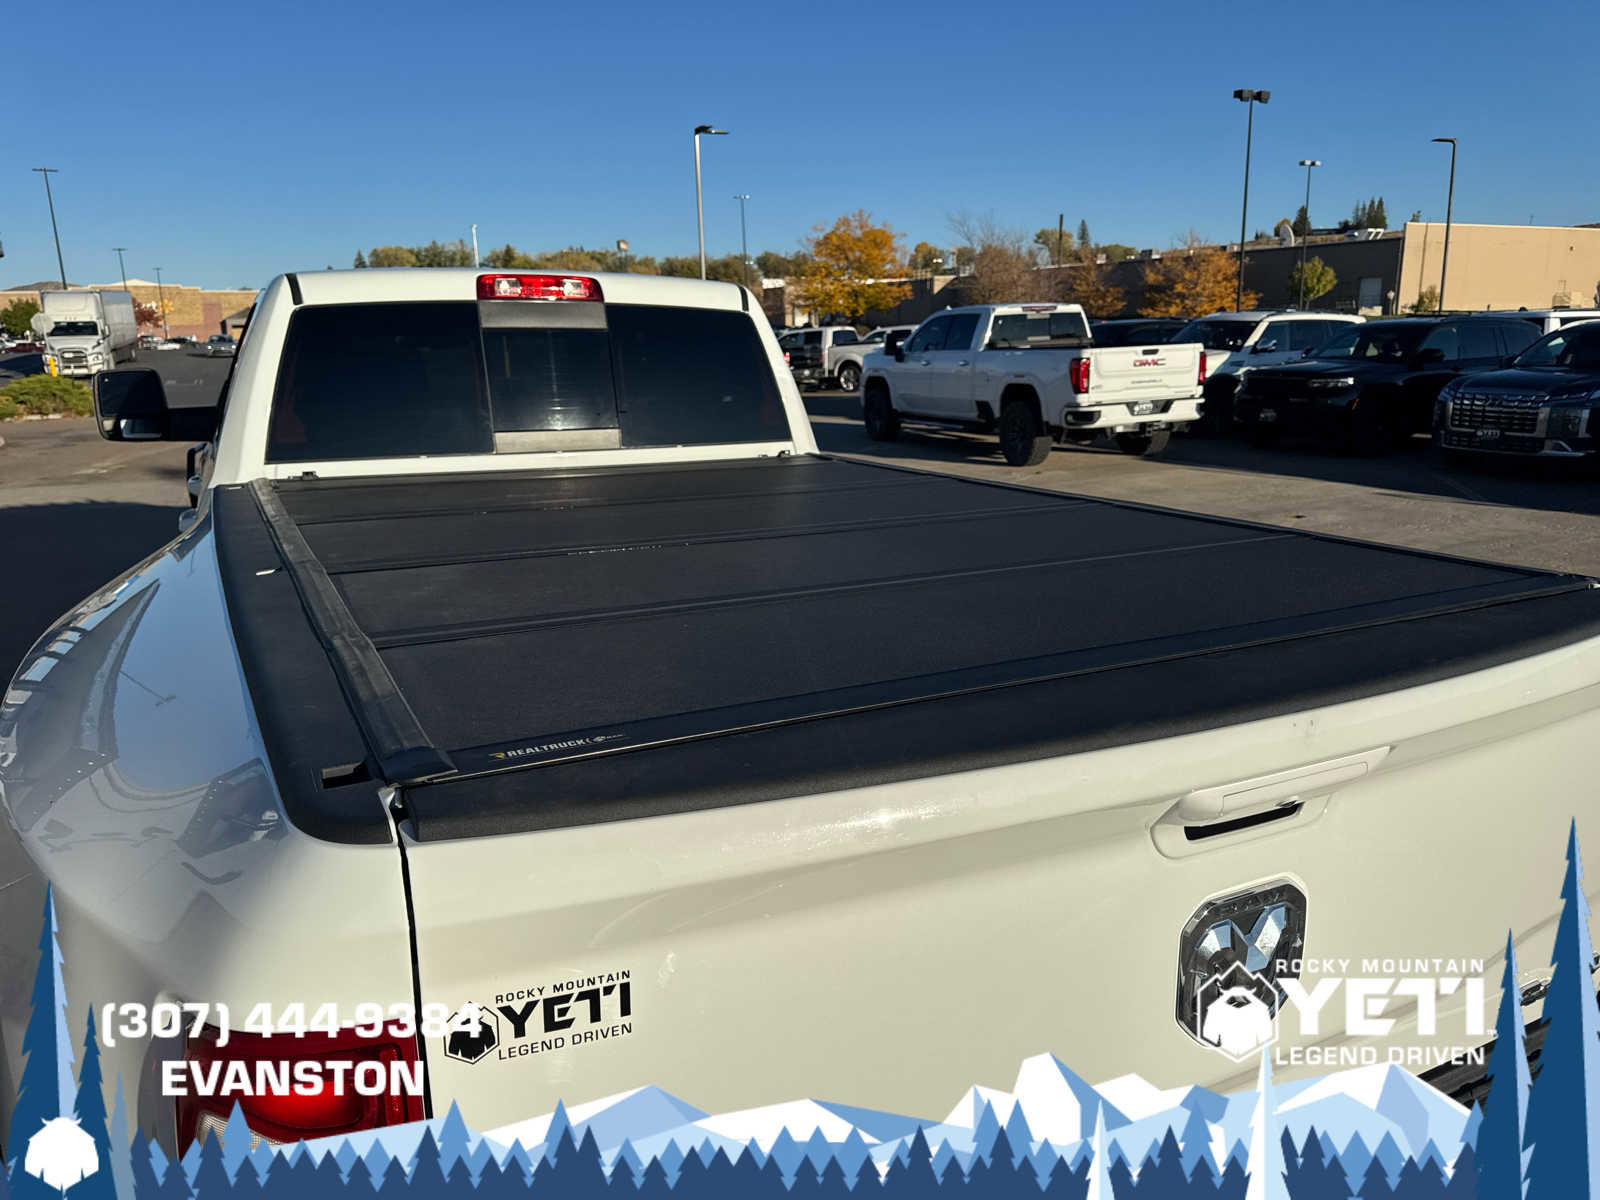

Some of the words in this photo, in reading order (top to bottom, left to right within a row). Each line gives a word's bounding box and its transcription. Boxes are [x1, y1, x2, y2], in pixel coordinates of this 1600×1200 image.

[1132, 358, 1167, 368] GMC
[506, 738, 586, 758] REALTRUCK
[495, 986, 545, 1004] ROCKY
[552, 969, 631, 994] MOUNTAIN
[496, 981, 632, 1039] YETI
[498, 1036, 566, 1061] LEGEND
[571, 1022, 633, 1046] DRIVEN
